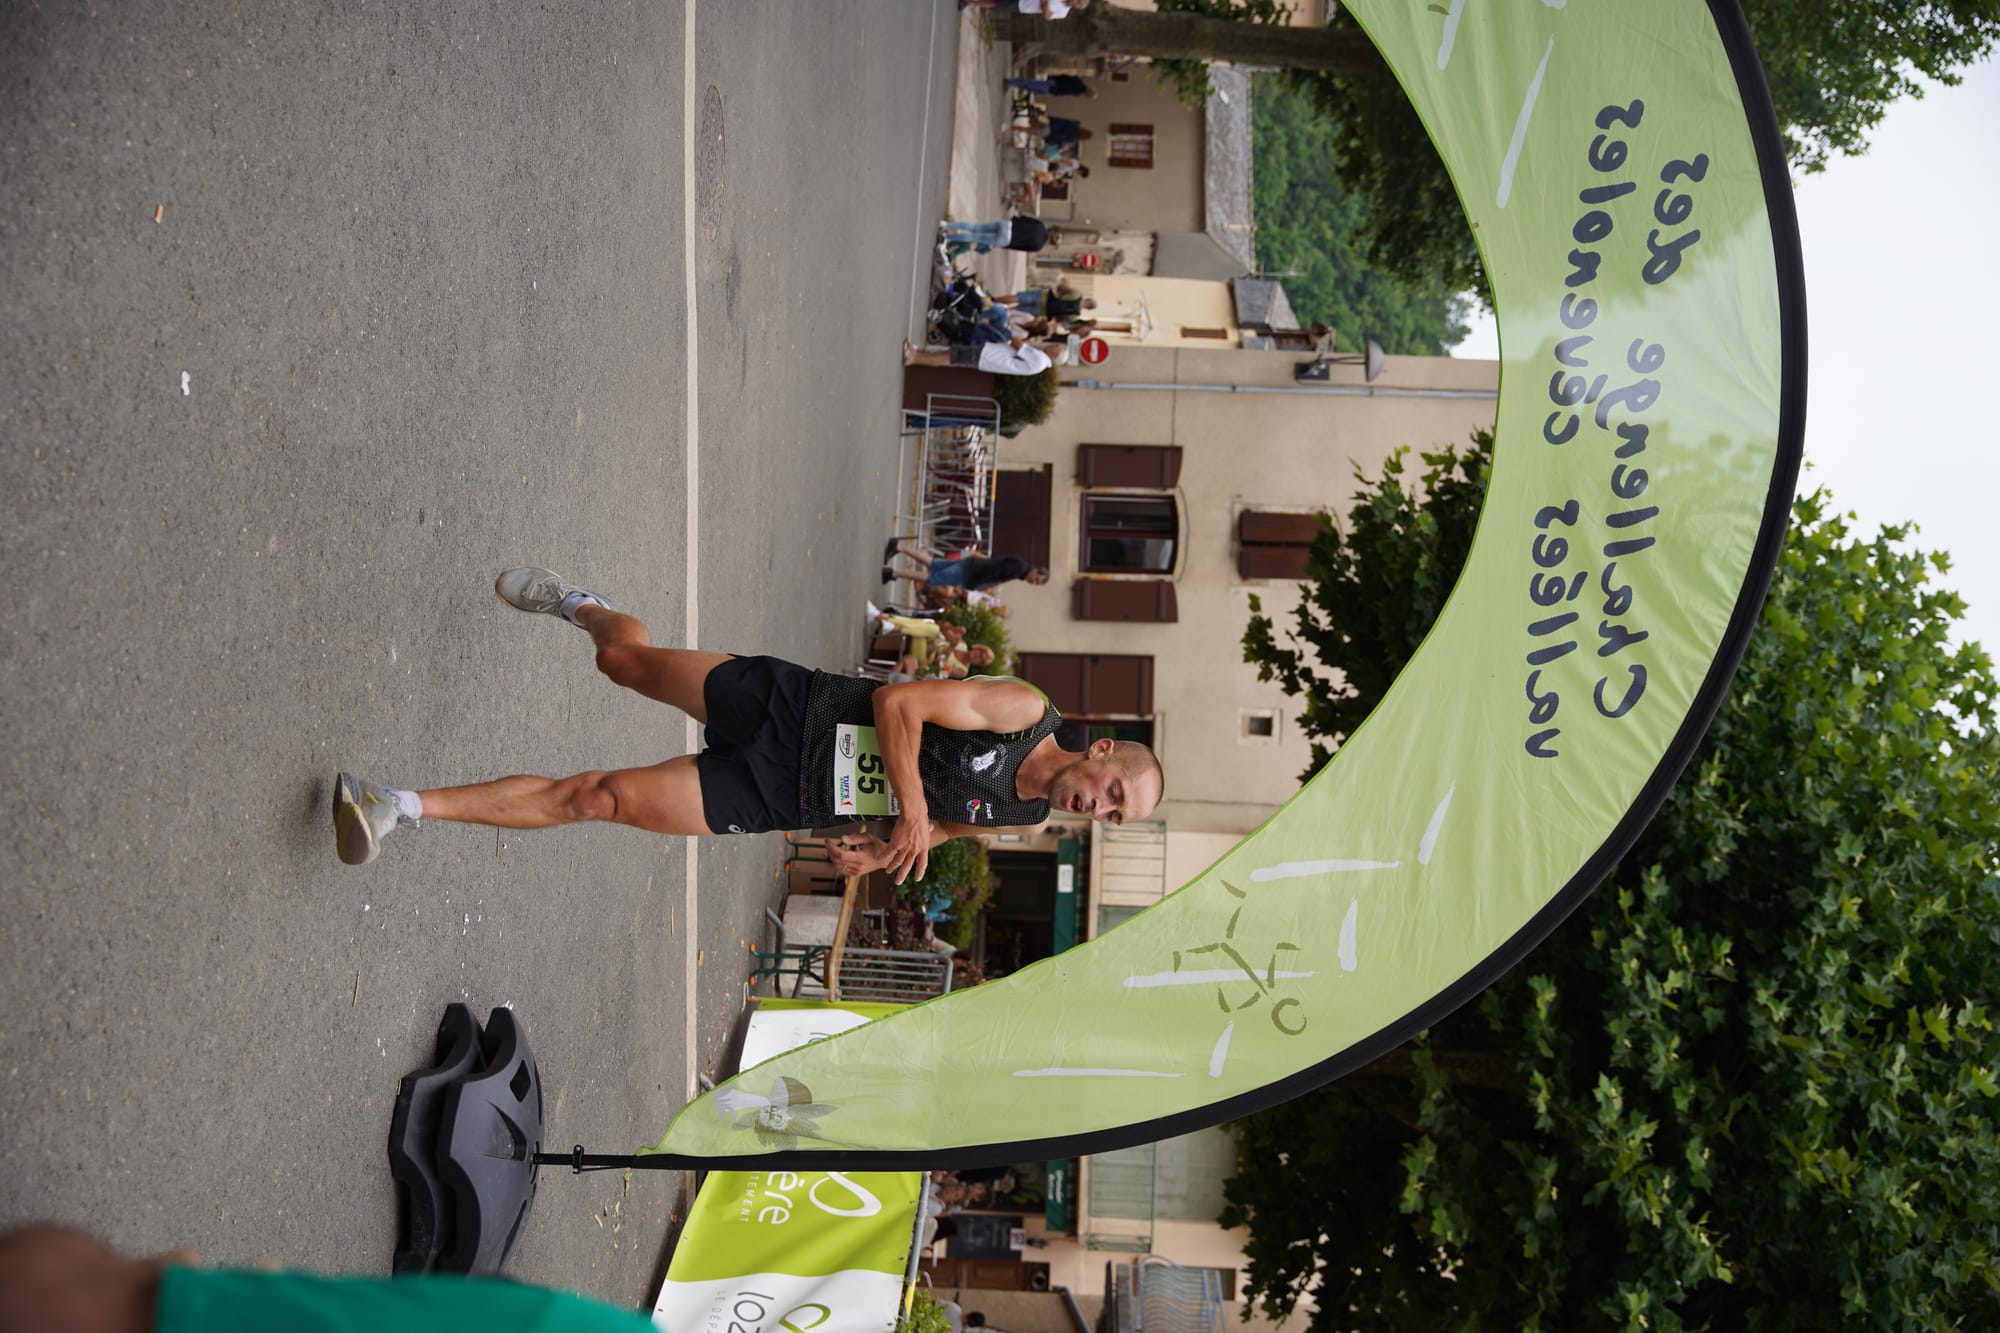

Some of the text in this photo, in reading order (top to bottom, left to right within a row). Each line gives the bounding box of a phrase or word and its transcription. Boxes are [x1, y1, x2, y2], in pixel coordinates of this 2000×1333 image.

[857, 752, 885, 795] 55
[738, 1175, 760, 1223] TEMENT
[758, 1171, 806, 1224] ère
